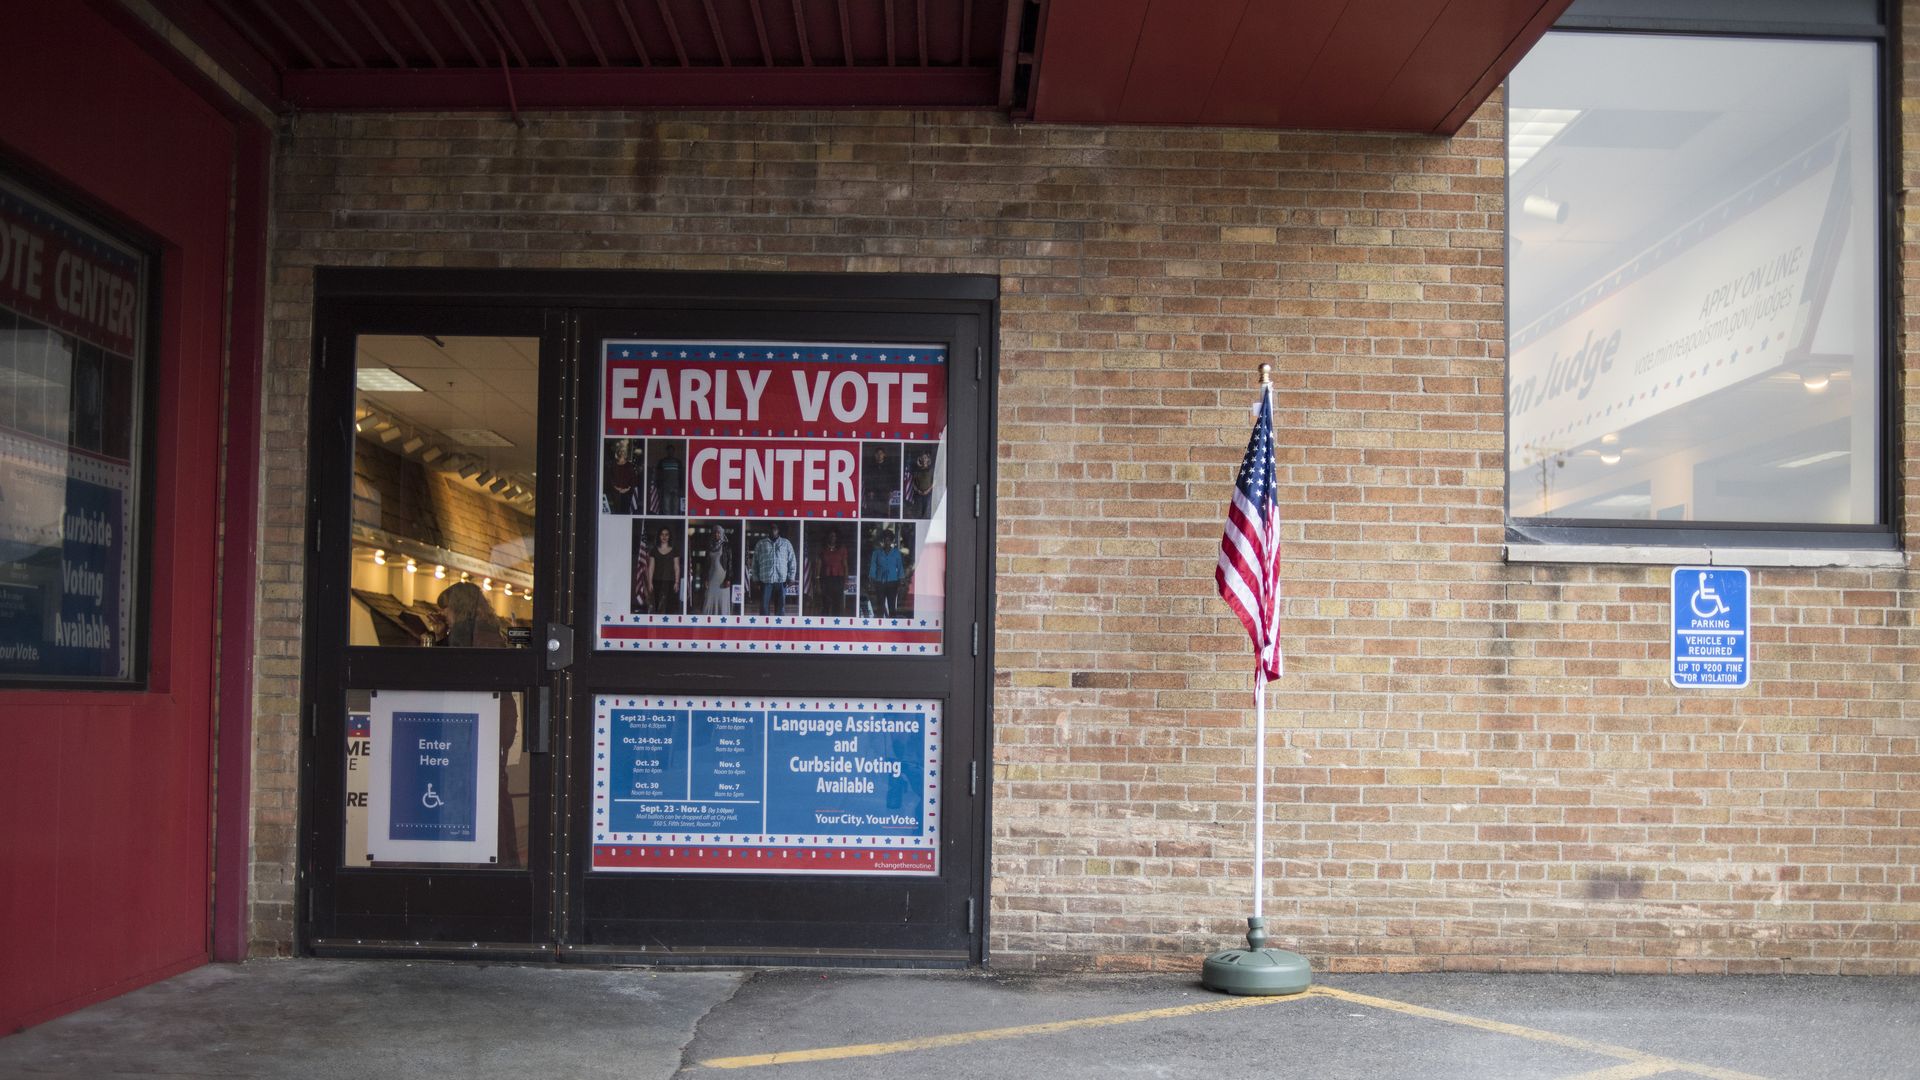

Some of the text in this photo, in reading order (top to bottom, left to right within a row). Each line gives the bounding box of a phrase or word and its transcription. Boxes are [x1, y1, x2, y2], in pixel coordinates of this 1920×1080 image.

[55, 249, 136, 339] CENTER
[1699, 277, 1744, 321] APPLY
[1633, 284, 1795, 377] vote.minneapolismn.gov/judges
[1534, 328, 1622, 408] Judge
[611, 367, 929, 425] EARLY VOTE
[691, 447, 856, 503] CENTER
[62, 560, 104, 607] Voting
[1691, 619, 1730, 628] PARKING
[55, 612, 111, 650] Available
[1685, 636, 1736, 645] VEHICLE ID
[1688, 646, 1733, 656] REQUIRED
[1678, 663, 1742, 672] UP TO $200 FINE
[1683, 673, 1738, 683] FOR VIOLATION
[620, 714, 636, 723] Sept
[773, 715, 920, 736] Language Assistance
[418, 739, 452, 750] Enter
[834, 736, 858, 752] and
[420, 755, 450, 766] Here
[635, 759, 650, 767] Oct.
[789, 756, 901, 778] Curbside Voting
[816, 777, 875, 793] Available
[640, 804, 663, 814] Sept.
[664, 805, 675, 813] 23
[680, 805, 700, 813] Nov.
[701, 805, 707, 813] 8
[815, 814, 919, 827] Your City. Your Vote.
[874, 862, 932, 871] #changetheroutine
